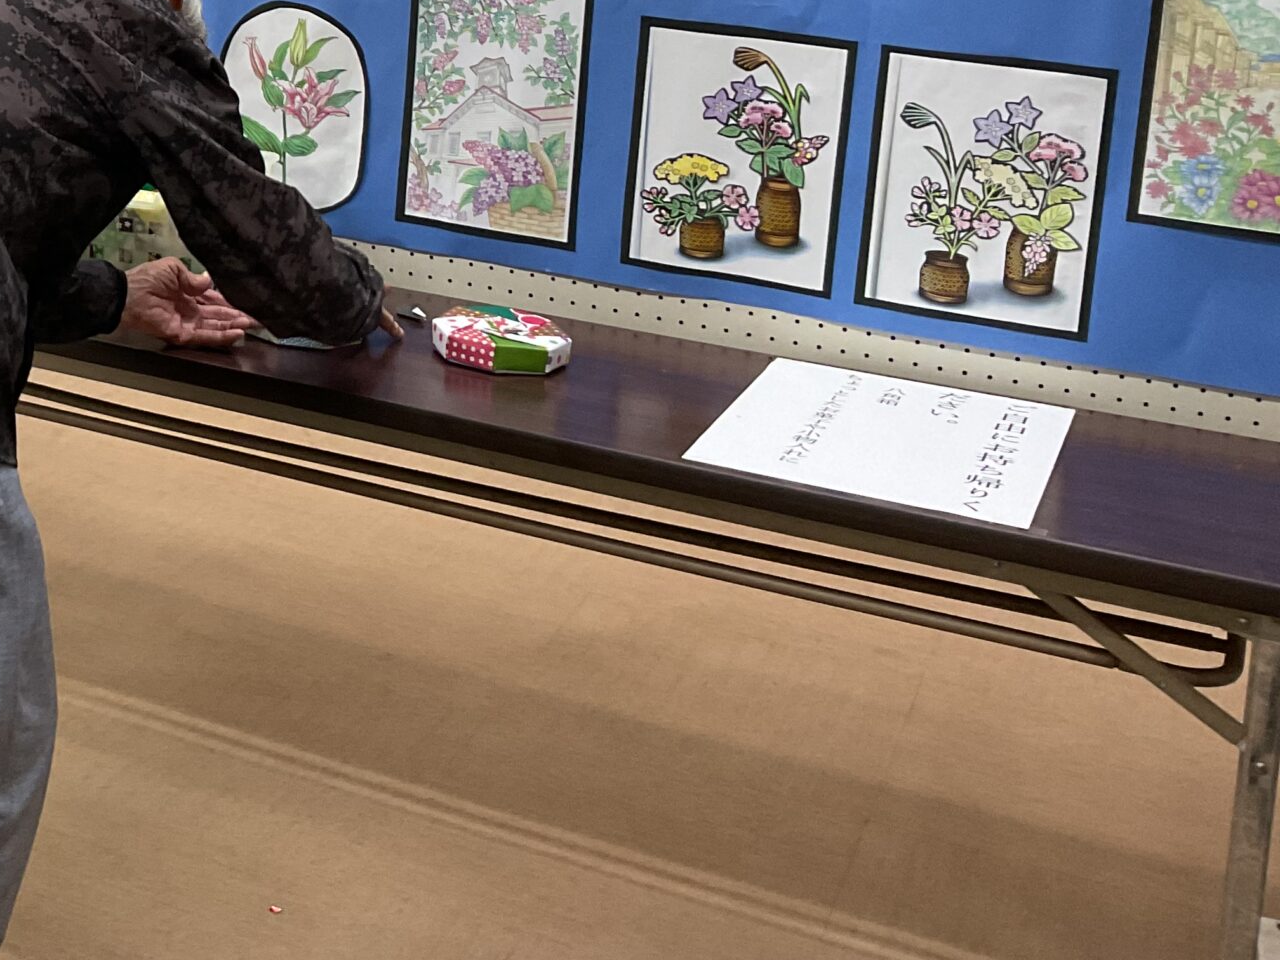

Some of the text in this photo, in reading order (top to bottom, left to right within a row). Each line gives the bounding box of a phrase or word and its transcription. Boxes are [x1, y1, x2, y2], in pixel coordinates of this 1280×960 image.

[931, 392, 969, 425] ださい。
[963, 403, 1038, 513] ご自由にお持ち帰りく
